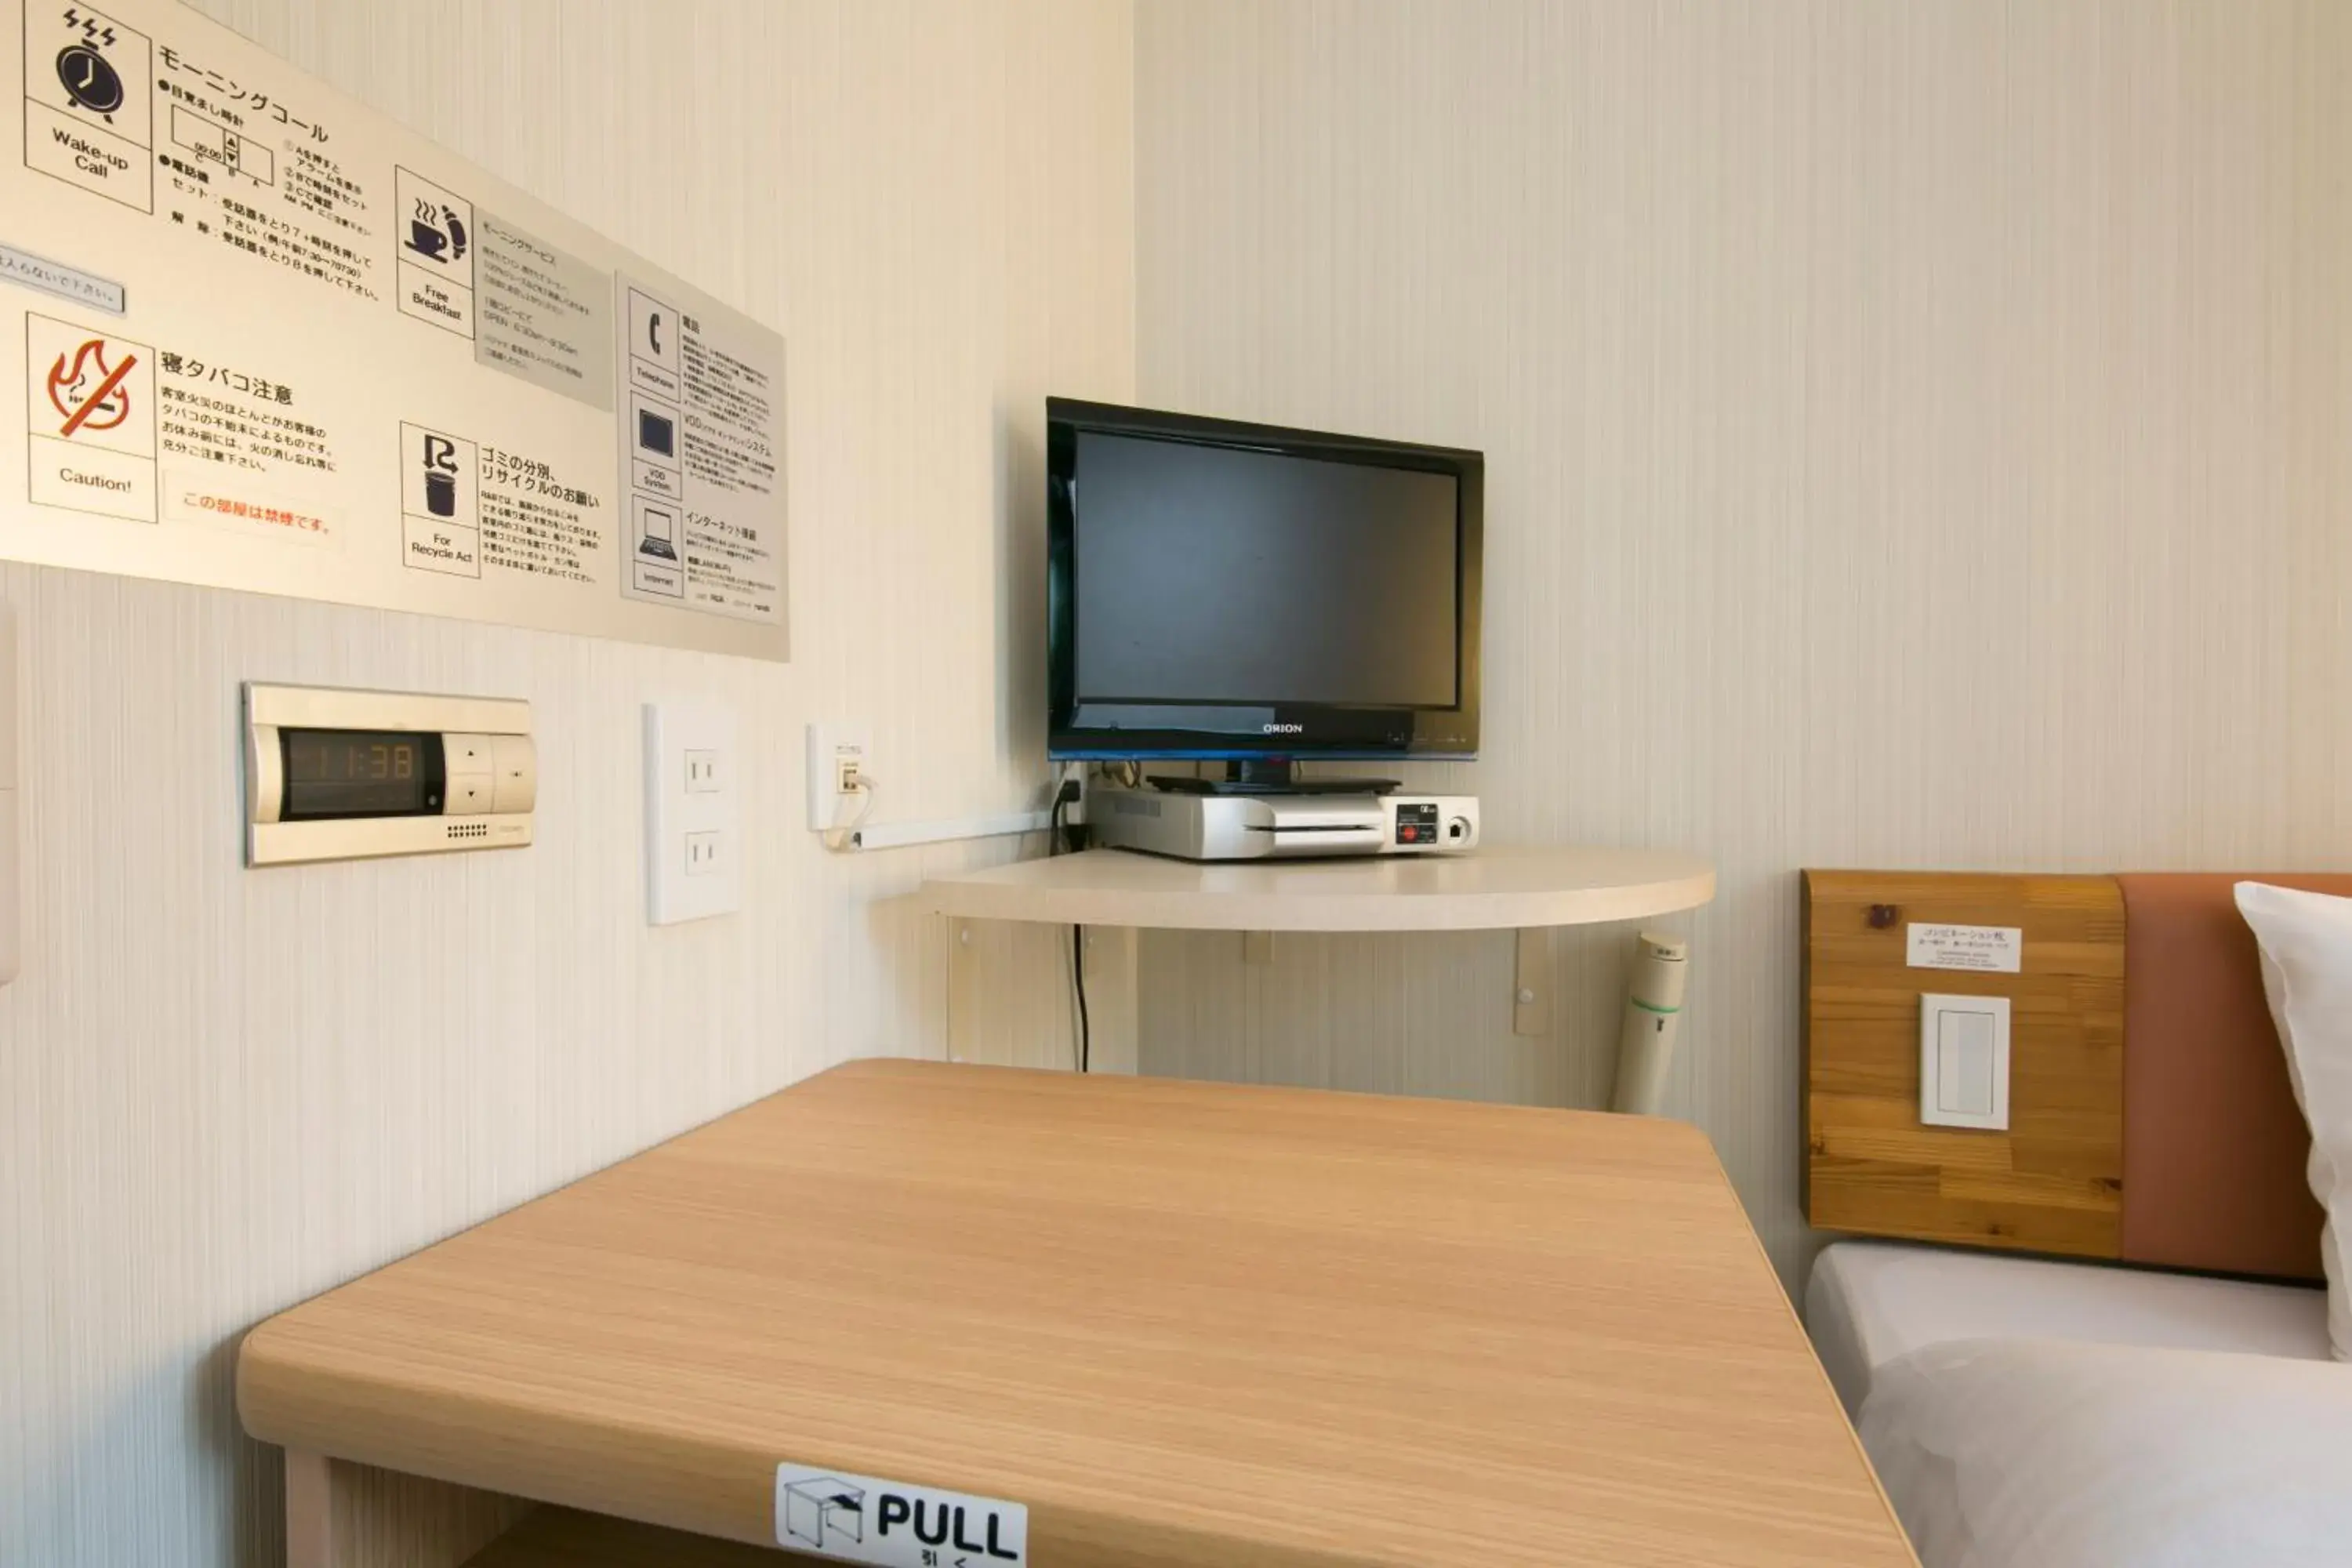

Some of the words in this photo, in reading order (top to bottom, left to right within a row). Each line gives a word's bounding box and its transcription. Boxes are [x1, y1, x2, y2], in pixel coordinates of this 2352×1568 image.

[158, 45, 328, 143] モーニングコール
[52, 126, 129, 171] Wake-up
[74, 154, 107, 179] Call
[0, 255, 114, 302] 入らないで下さい。
[425, 285, 449, 303] Free
[412, 292, 462, 320] Breakfast
[162, 350, 293, 405] 寝タバコ注意
[60, 467, 131, 493] Caution!
[481, 464, 601, 508] リサイクルのお願い
[183, 492, 329, 535] この部屋は禁煙です。
[412, 542, 454, 561] Recycle
[456, 551, 473, 564] Act
[434, 533, 452, 546] For
[1264, 724, 1302, 733] ORION
[320, 746, 413, 779] 11:38
[877, 1493, 1018, 1561] PULL
